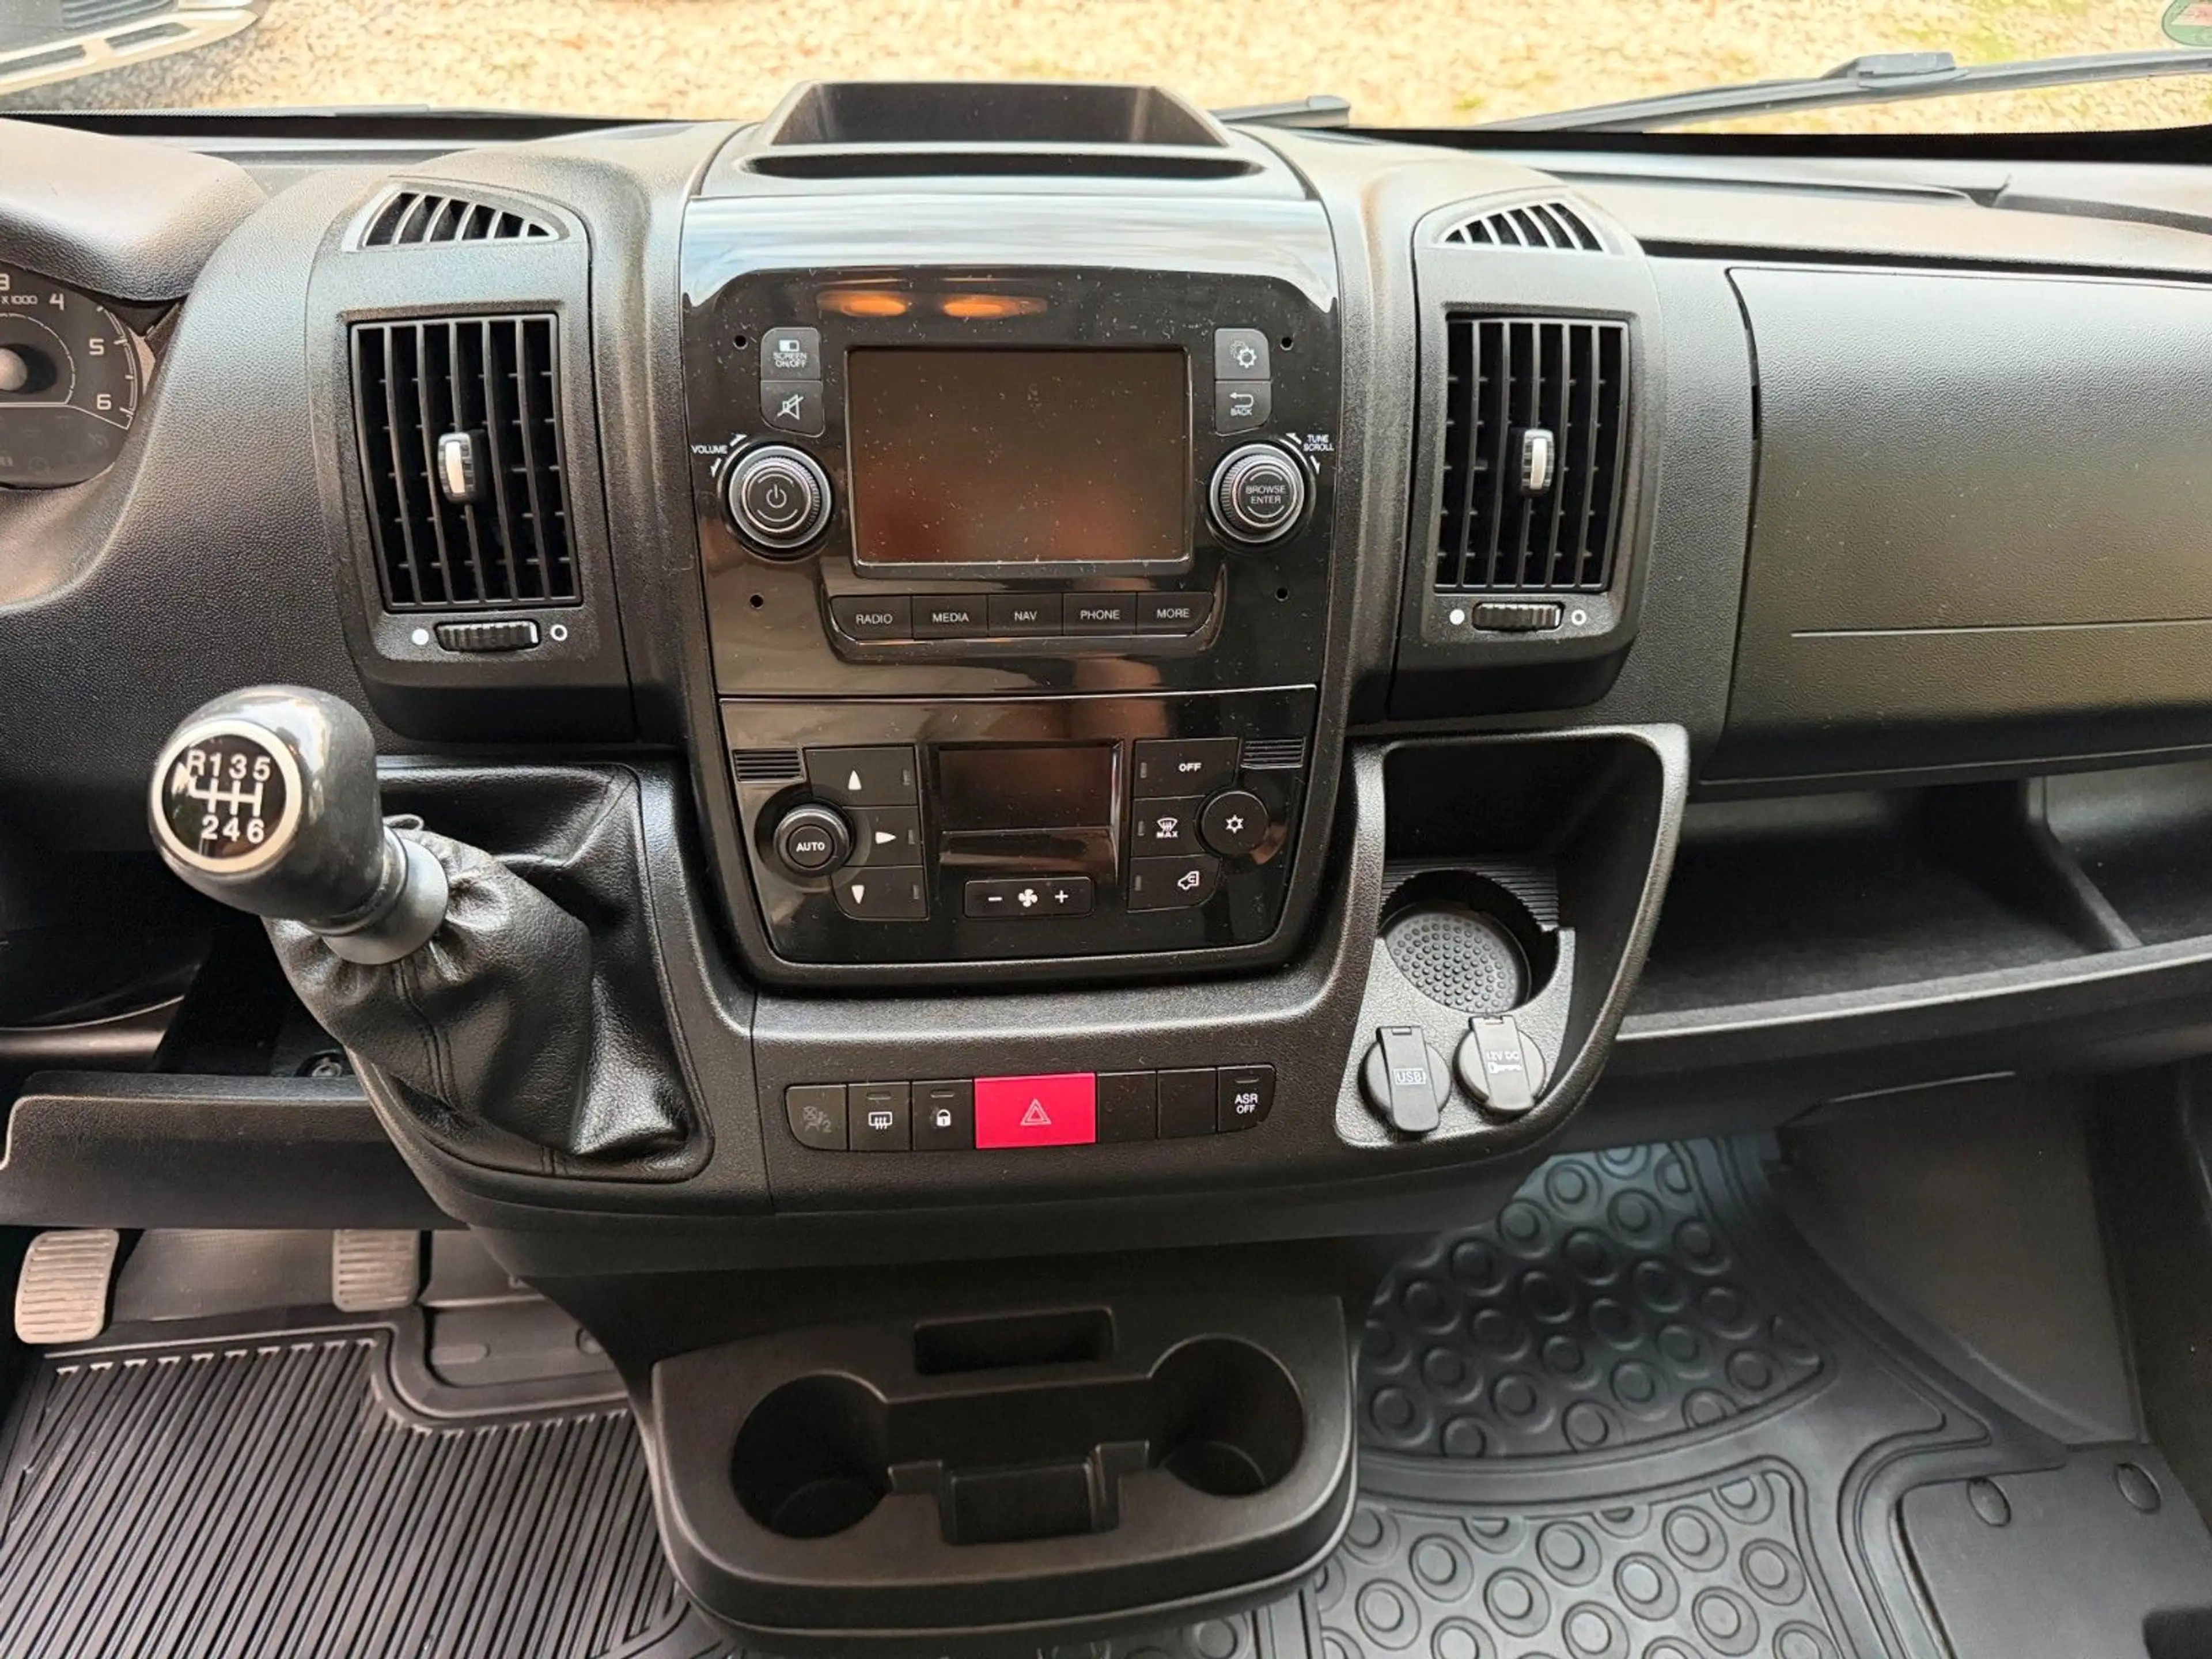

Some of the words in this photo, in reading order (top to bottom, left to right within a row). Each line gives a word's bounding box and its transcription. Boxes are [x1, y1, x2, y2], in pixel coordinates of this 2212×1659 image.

[49, 293, 65, 310] 4
[89, 339, 104, 355] 5
[773, 352, 807, 360] SCREEN
[775, 359, 806, 368] ON/OFF
[97, 394, 111, 410] 6
[1230, 407, 1252, 416] BACK
[1306, 434, 1329, 443] TUNE
[691, 445, 728, 454] VOLUME
[1303, 443, 1334, 452] SCROLL
[1245, 484, 1286, 494] BROWSE
[1251, 495, 1281, 505] ENTER
[855, 613, 893, 624] RADIO
[932, 612, 969, 623] MEDIA
[1014, 610, 1037, 621] NAV
[1080, 609, 1120, 620] PHONE
[1157, 608, 1190, 619] MORE
[187, 749, 206, 777] R
[210, 752, 222, 777] 1
[229, 753, 247, 779] 3
[252, 755, 271, 782] 5
[1179, 763, 1202, 772] OFF
[202, 814, 219, 840] 2
[222, 817, 241, 842] 4
[247, 818, 265, 844] 6
[1157, 831, 1179, 839] MAX
[796, 842, 825, 852] AUTO
[1486, 1050, 1502, 1061] 12V
[1397, 1071, 1422, 1082] USB
[1234, 1093, 1258, 1104] ASR
[1236, 1104, 1256, 1114] OFF
